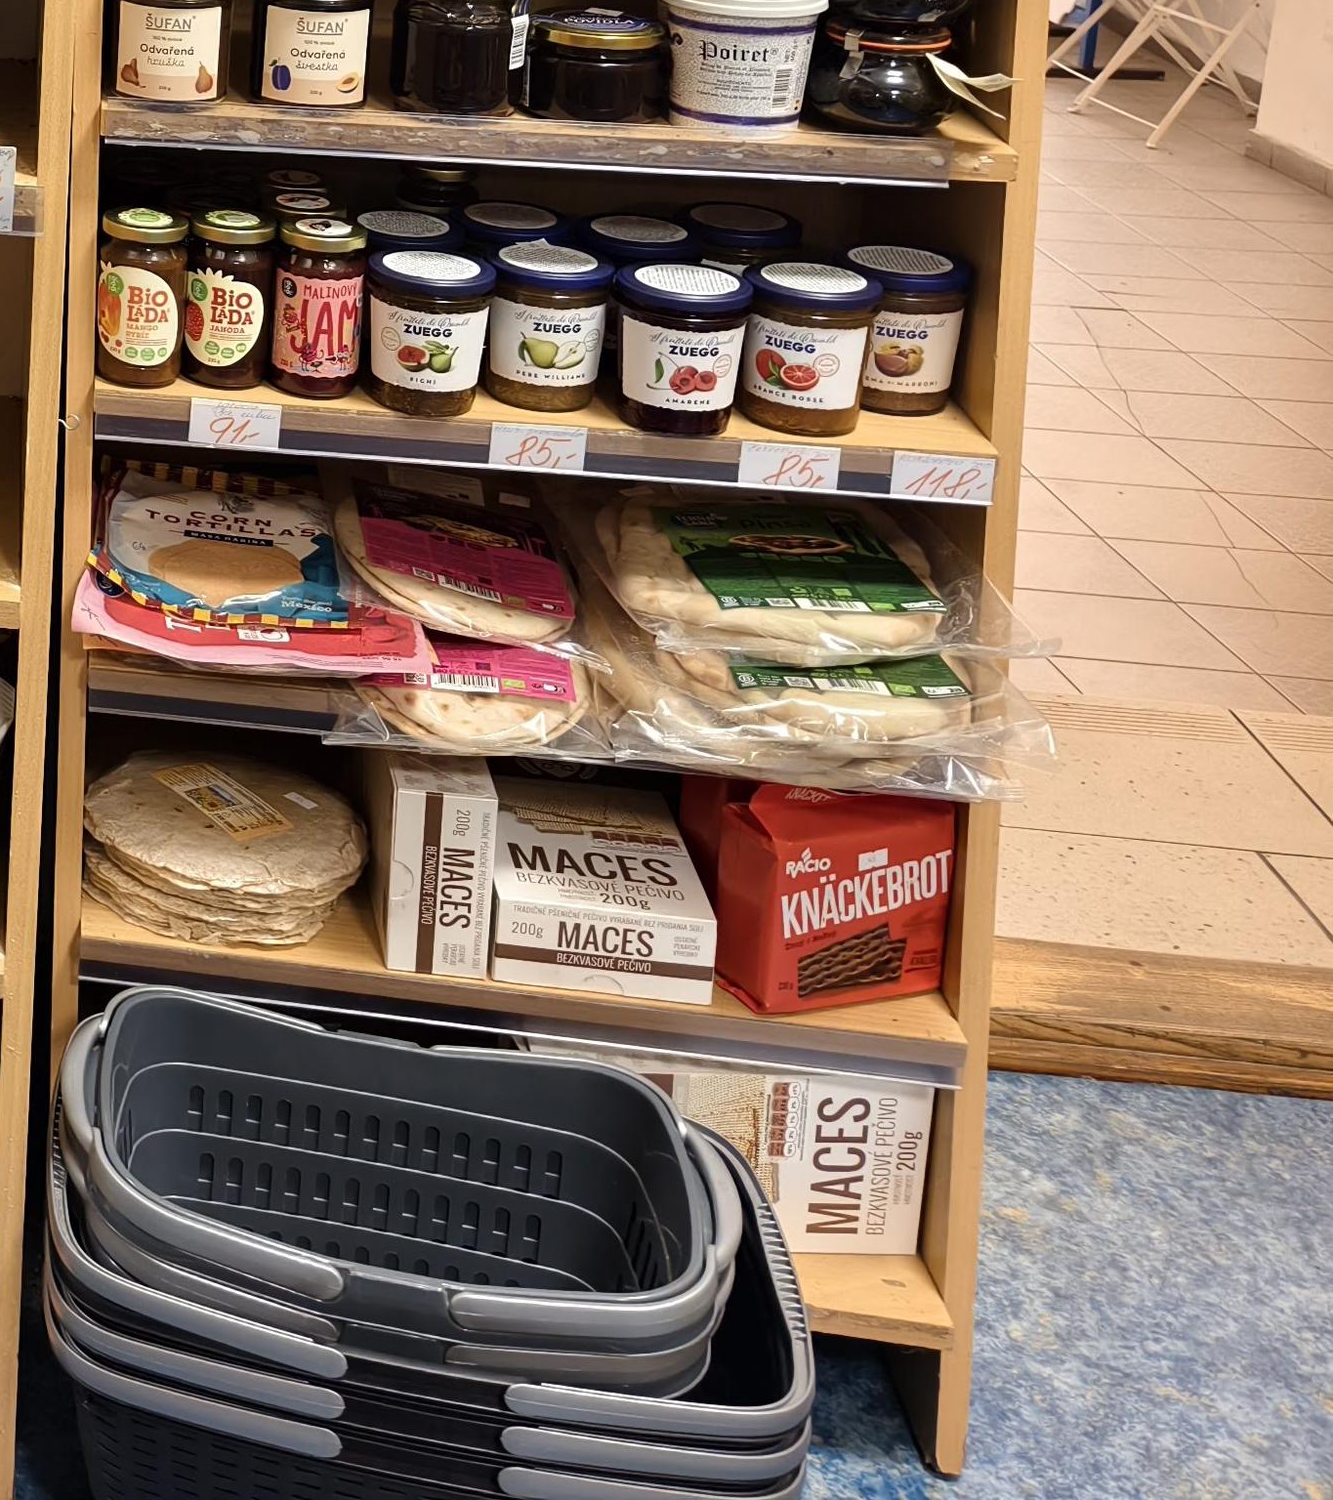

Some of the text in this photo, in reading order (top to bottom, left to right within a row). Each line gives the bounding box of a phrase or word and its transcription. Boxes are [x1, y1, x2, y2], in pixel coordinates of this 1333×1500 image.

[145, 13, 192, 30] ŠUFAN
[296, 16, 343, 34] ŠUFAN
[140, 44, 194, 56] Odvařená
[290, 48, 346, 60] Odvařená
[698, 39, 768, 63] Poiret
[147, 55, 185, 67] hruška
[295, 60, 339, 72] švestka
[304, 283, 357, 300] MALINOVÝ
[289, 300, 359, 352] JAM
[403, 324, 453, 337] ZUEGG
[765, 336, 816, 353] ZUEGG
[190, 510, 272, 529] CORN
[281, 600, 332, 614] Mexico
[505, 841, 678, 889] MACES
[439, 847, 475, 930] MACES
[515, 871, 685, 902] BEZKVASOVÉ PEČIVO
[781, 849, 953, 938] KNÄCKEBROT
[600, 892, 650, 912] 200g
[557, 922, 654, 958] MACES
[556, 952, 652, 972] BEZKVASOVÉ PEČIVO
[806, 1097, 872, 1235] MACES
[865, 1098, 899, 1235] BEZKVASOVÉ PEČIVO
